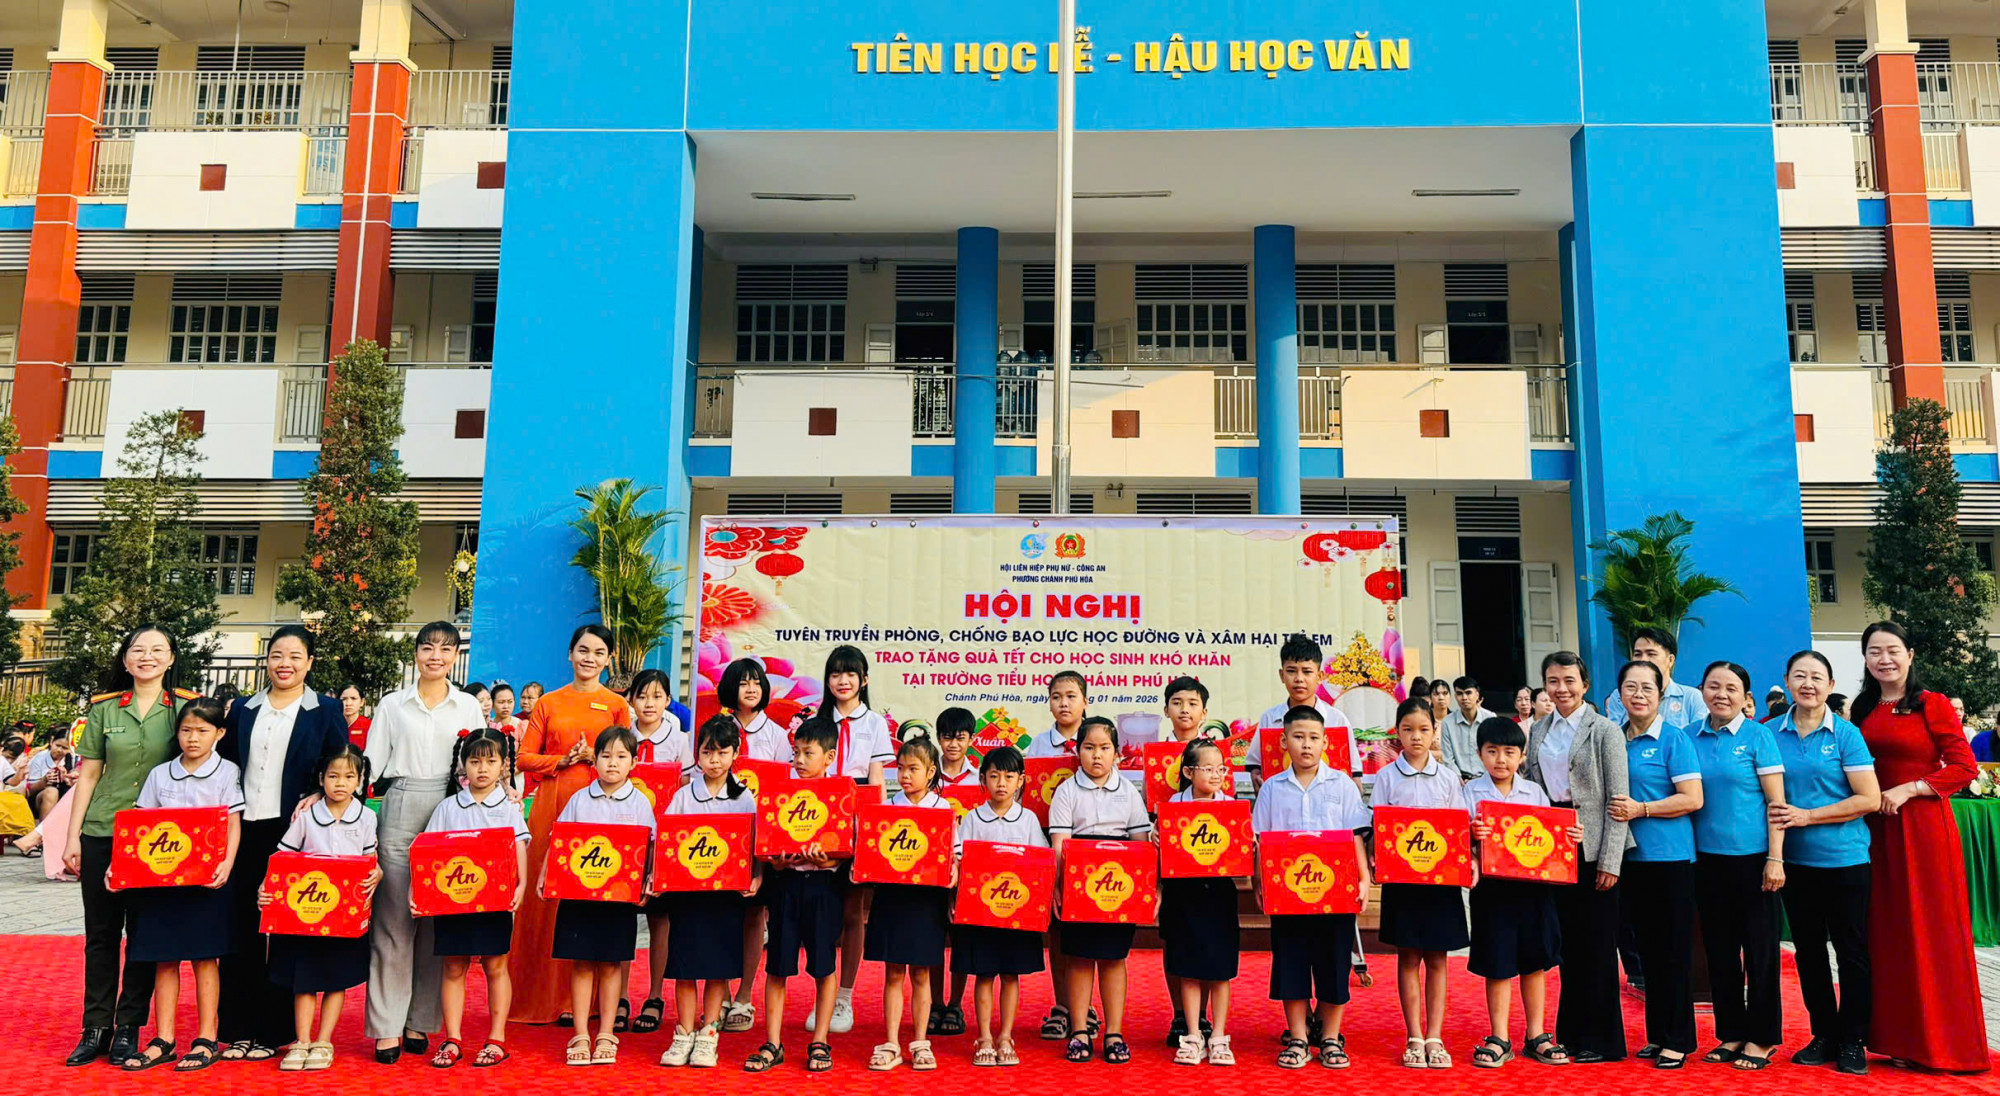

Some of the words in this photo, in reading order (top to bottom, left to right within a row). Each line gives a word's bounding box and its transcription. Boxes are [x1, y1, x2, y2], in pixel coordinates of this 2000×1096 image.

[852, 33, 942, 73] TIÊN
[954, 43, 1037, 80] HỌC
[1135, 34, 1217, 79] HẬU
[1230, 39, 1313, 79] HỌC
[1324, 31, 1410, 71] VĂN
[1096, 564, 1106, 572] AN
[964, 589, 1032, 624] HỘI
[1046, 594, 1141, 624] NGHỊ
[775, 626, 820, 641] TUYÊN
[825, 624, 880, 642] TRUYỀN
[884, 626, 944, 644] PHÒNG,
[949, 625, 1008, 642] CHỐNG
[1012, 630, 1045, 646] BẠO
[1049, 629, 1078, 646] LỰC
[1083, 630, 1118, 647] HỌC
[1123, 628, 1180, 644] ĐƯỜNG
[1184, 628, 1206, 644] VÀ
[1211, 629, 1246, 645] XÂM
[1251, 632, 1278, 648] HẠI
[875, 651, 914, 664] TRAO
[919, 649, 961, 667] TẶNG
[964, 649, 999, 665] QUÀ
[1003, 647, 1026, 664] TẾT
[1029, 652, 1065, 665] CHO
[1069, 653, 1105, 668] HỌC
[1109, 653, 1145, 666] SINH
[1149, 649, 1183, 666] KHÓ
[1188, 652, 1231, 666] KHĂN
[902, 672, 925, 688] TẠI
[930, 670, 993, 686] TRƯỜNG
[997, 667, 1027, 686] TIỂU
[1084, 671, 1128, 687] HÁNH
[1132, 672, 1163, 687] PHÚ
[945, 692, 977, 702] Chánh
[979, 692, 999, 702] Phú
[1001, 693, 1023, 704] Hòa,
[1026, 693, 1050, 704] ngày
[1097, 694, 1108, 703] 01
[1111, 694, 1133, 703] năm
[1135, 695, 1158, 703] 2026
[974, 736, 1006, 747] Xuân
[788, 799, 819, 823] An
[149, 831, 183, 856] An
[889, 828, 920, 852] An
[1190, 823, 1221, 847] An
[1406, 830, 1438, 853] An
[1514, 826, 1545, 847] An
[580, 846, 613, 869] An
[688, 836, 720, 860] An
[445, 864, 479, 888] An
[1095, 870, 1126, 893] An
[1294, 863, 1327, 886] An
[297, 881, 331, 904] An
[990, 880, 1021, 900] An
